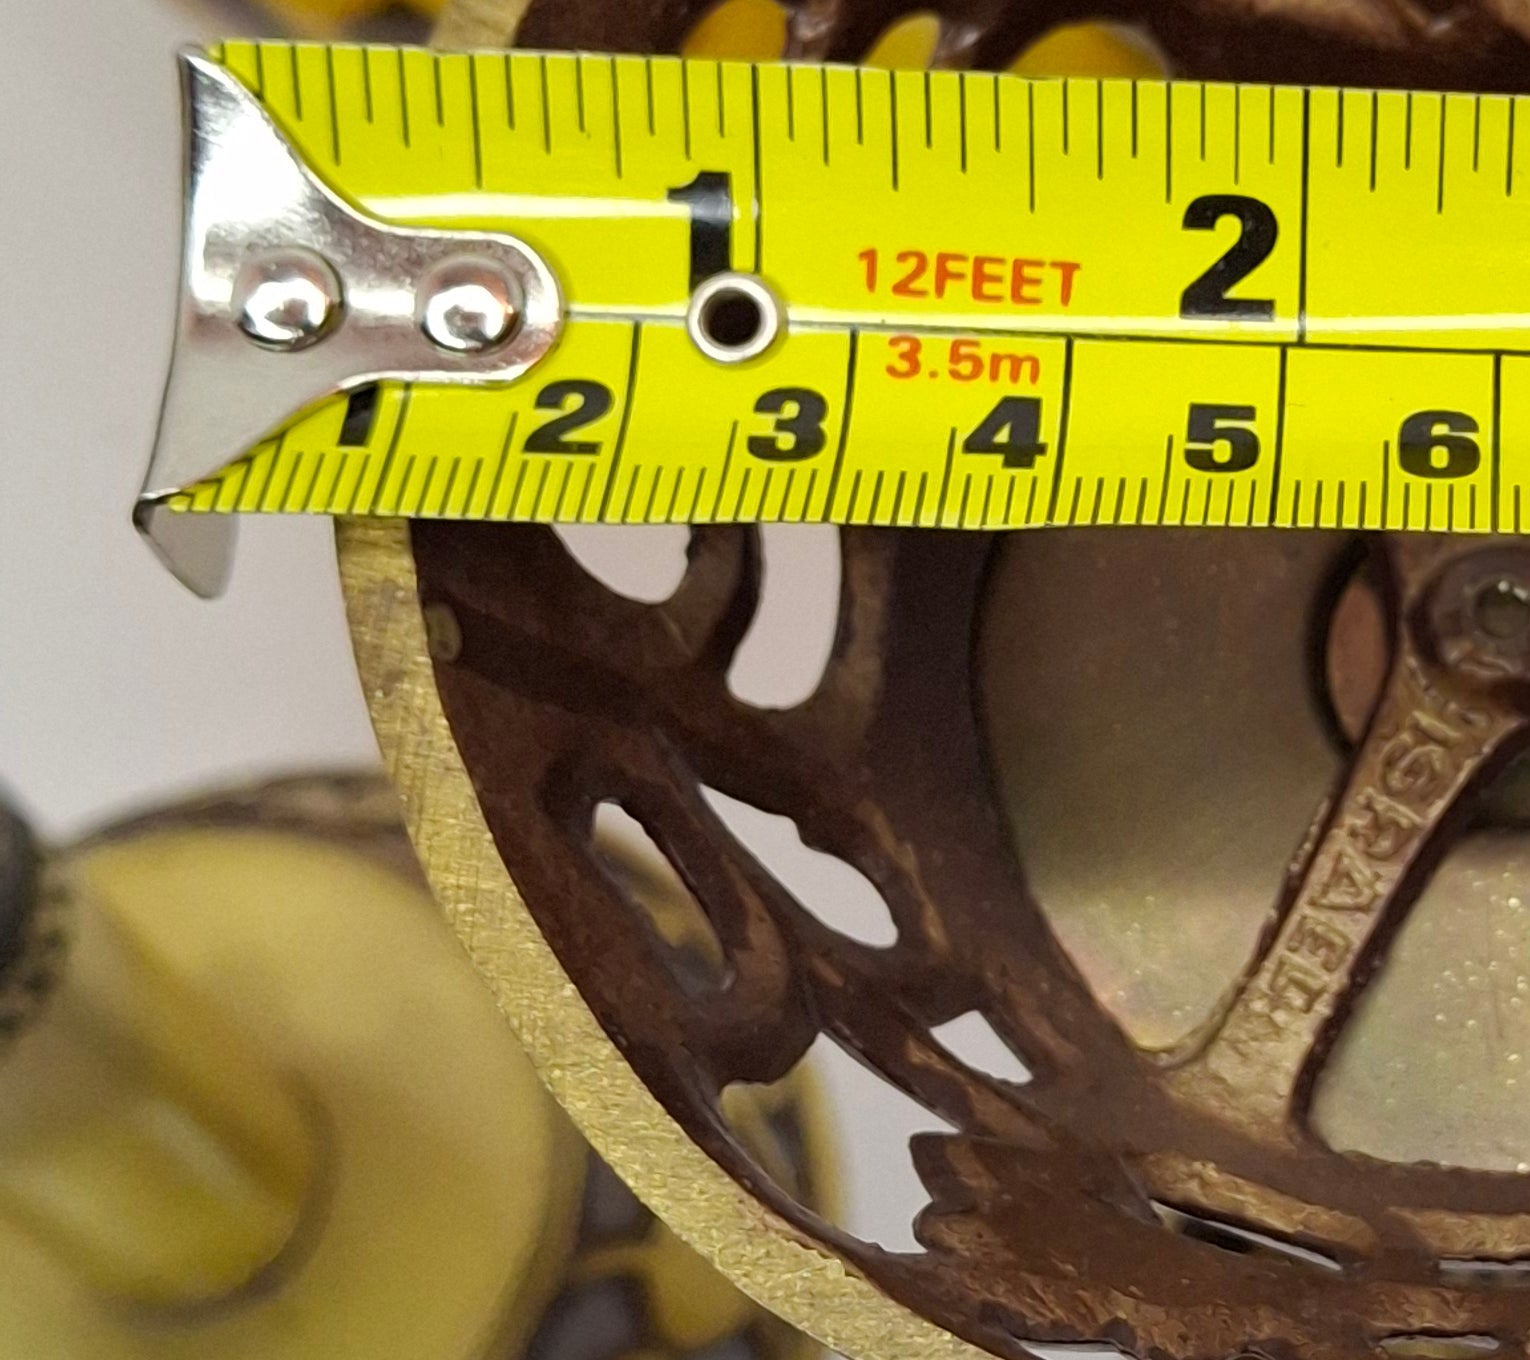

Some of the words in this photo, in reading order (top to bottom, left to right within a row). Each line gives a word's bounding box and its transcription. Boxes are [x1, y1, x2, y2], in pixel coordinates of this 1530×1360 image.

[668, 171, 731, 293] 1
[1180, 195, 1278, 322] 2
[859, 248, 1080, 307] 12FEET
[886, 335, 1041, 385] 3.5m
[523, 381, 612, 455] 2
[747, 387, 827, 462] 3
[962, 396, 1047, 469] 4
[1184, 404, 1259, 474] 5
[1398, 410, 1480, 479] 6
[1264, 708, 1462, 1014] ISRAEL
